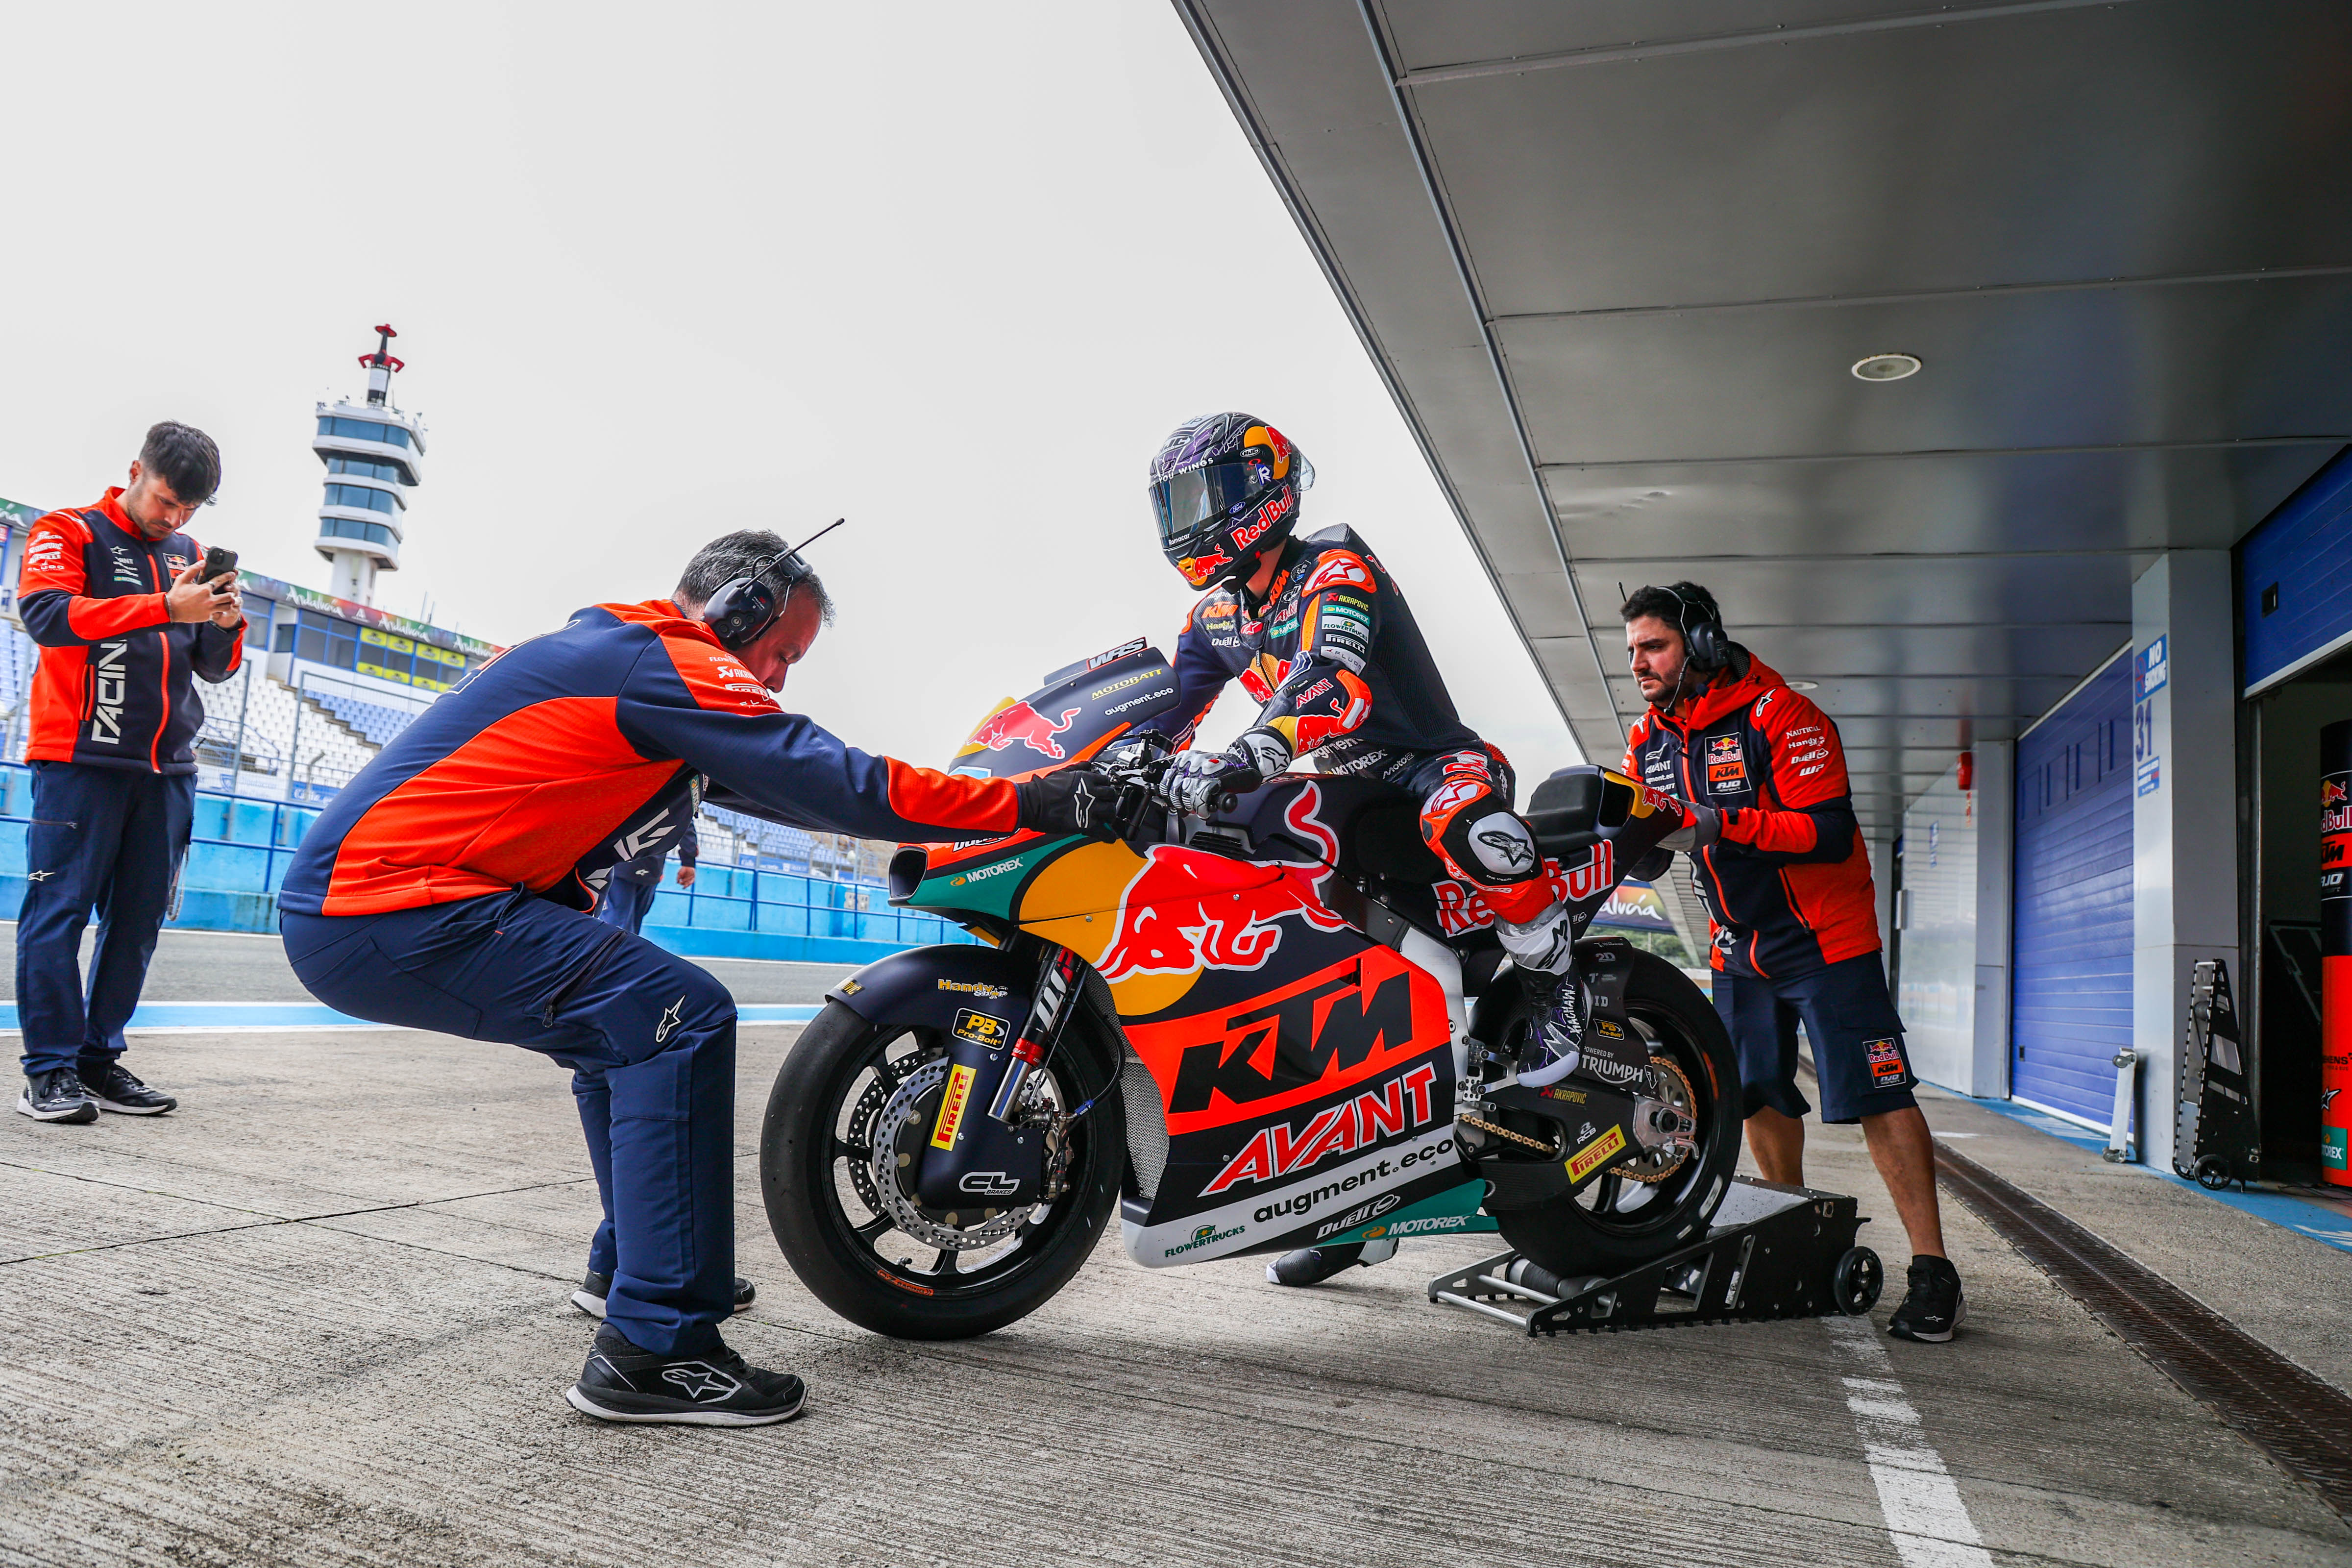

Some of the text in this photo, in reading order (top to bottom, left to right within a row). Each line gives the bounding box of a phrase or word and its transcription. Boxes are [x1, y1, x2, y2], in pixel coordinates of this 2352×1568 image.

[1159, 457, 1214, 484] YOU WINGS
[1230, 484, 1294, 551] Red Bull
[1232, 503, 1243, 513] Ford
[1168, 534, 1190, 545] Romacar
[1201, 601, 1239, 618] KTM
[1335, 606, 1369, 624] MOTOREX
[1323, 623, 1368, 642] FLOWERTRUCKS
[1325, 633, 1366, 654] PIRELLI
[1088, 638, 1145, 669] WRS
[2148, 640, 2162, 669] NO
[91, 638, 127, 745] RACIN
[1092, 668, 1162, 699] MOTOBATT
[1295, 678, 1334, 710] AVANT
[1104, 687, 1175, 716] augment.eco
[1785, 725, 1821, 739] NAUTICAL
[2135, 698, 2152, 762] 31
[1788, 737, 1817, 749] Handy
[1382, 752, 1415, 780] Moto2
[1708, 748, 1742, 764] Red Bull
[1715, 765, 1739, 778] KTM
[1715, 780, 1741, 789] AJO
[966, 858, 1024, 883] MOTOREX
[1431, 880, 1495, 938] Re
[1599, 892, 1663, 921] alucía
[1595, 952, 1616, 963] 2D
[938, 979, 995, 992] Handy
[966, 1013, 998, 1035] PB
[1601, 1021, 1617, 1032] PB
[1168, 971, 1414, 1115] KTM
[1868, 1050, 1899, 1063] Red Bull
[1582, 1054, 1643, 1084] TRIUMPH
[1877, 1063, 1898, 1074] KTM
[936, 1072, 969, 1143] PIRELLI
[1197, 1061, 1438, 1198] AVANT
[1576, 1127, 1597, 1145] RCB
[1570, 1132, 1619, 1176] PIRELLI
[2323, 1144, 2343, 1160] TOREX
[1253, 1138, 1454, 1223] augment.eco
[1388, 1215, 1470, 1235] MOTOREX
[1164, 1225, 1246, 1257] FLOWERTRUCKS
